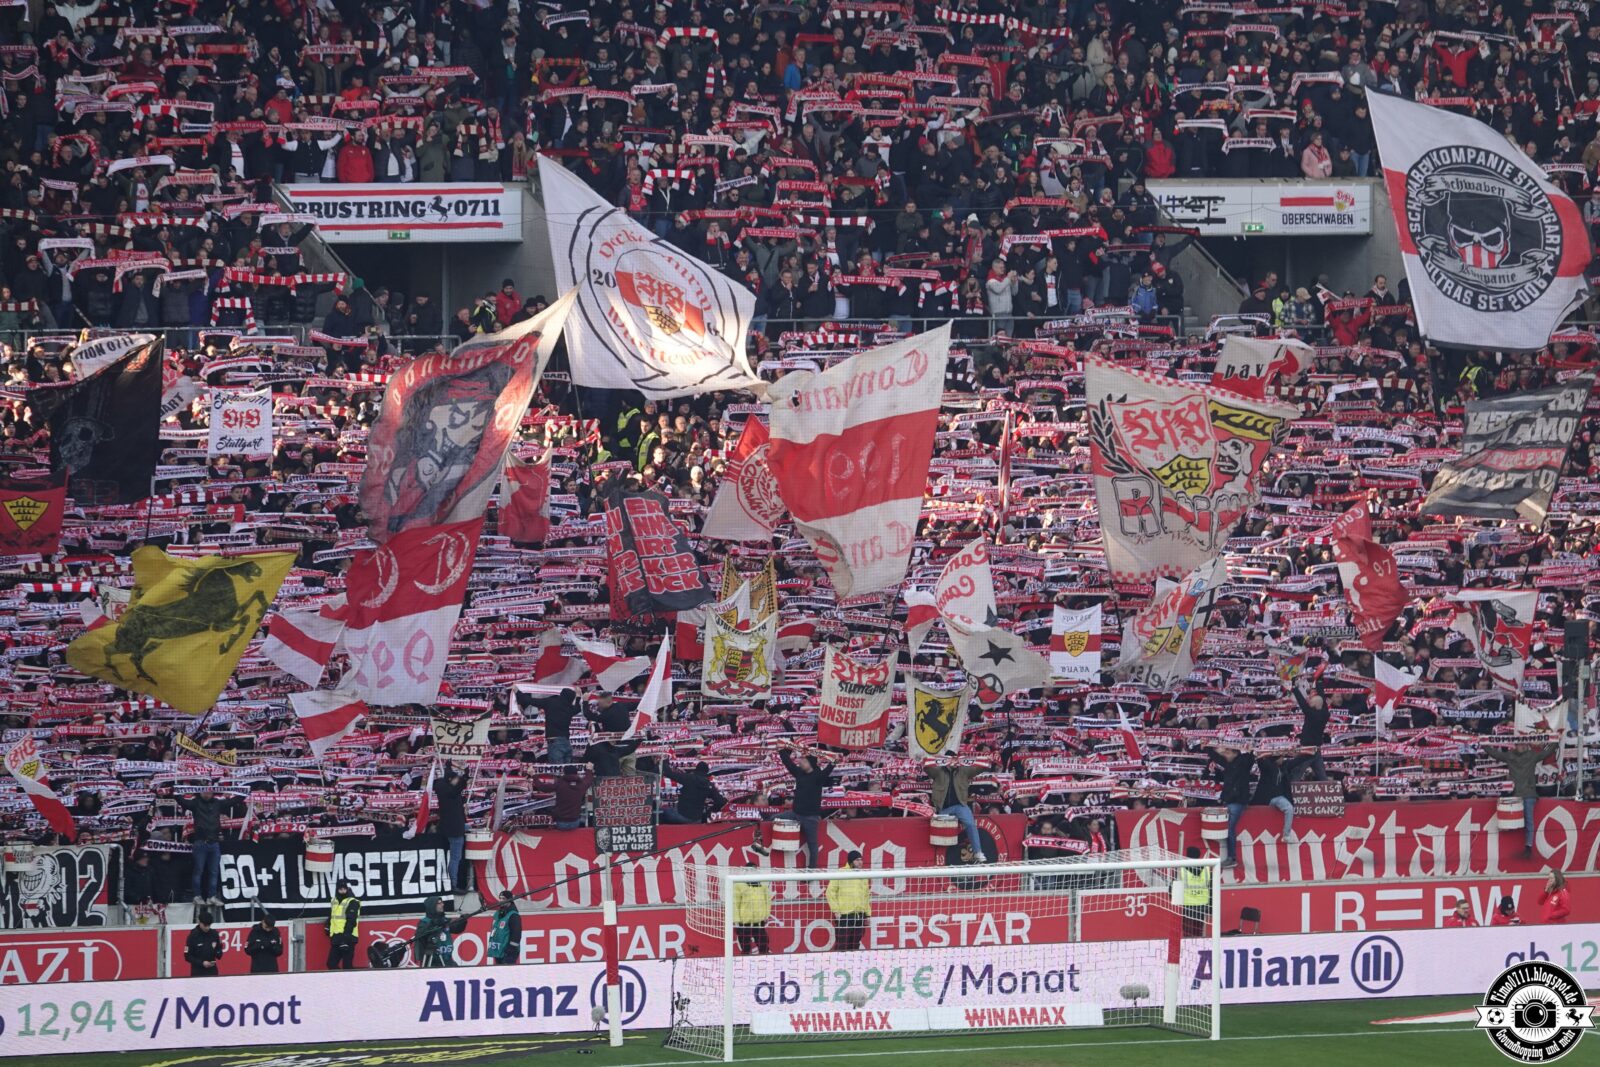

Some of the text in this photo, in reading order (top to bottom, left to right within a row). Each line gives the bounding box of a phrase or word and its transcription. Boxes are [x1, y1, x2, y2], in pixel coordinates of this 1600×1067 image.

[454, 199, 501, 217] 0711
[1281, 212, 1354, 226] OBERSCHWABEN
[592, 268, 616, 289] 20
[107, 334, 136, 357] 0711
[222, 408, 261, 430] VfB
[215, 436, 265, 453] Stuttgart
[203, 535, 251, 544] STUTTGART
[835, 695, 866, 709] HEISST
[820, 704, 857, 726] UNSER
[1441, 708, 1508, 719] KESSELSTADT
[839, 727, 880, 747] VEREIN
[1488, 735, 1550, 743] COMMANDO
[600, 776, 645, 786] JEDER
[1478, 783, 1503, 791] RAS
[593, 784, 652, 798] VERBANNTE
[1325, 784, 1342, 793] IST
[1417, 787, 1440, 795] RAS
[600, 796, 647, 807] KEHRT
[821, 799, 872, 808] Commando
[1314, 806, 1345, 817] GANZE
[612, 825, 653, 835] DU BIST
[612, 833, 654, 844] IMMER
[146, 840, 193, 852] COMMAN
[612, 842, 654, 851] BEI UNS!
[219, 848, 452, 900] 50+1 UMSETZEN
[1124, 894, 1148, 918] 35
[784, 911, 1032, 953] JOERSTAR
[219, 930, 243, 952] 34
[1191, 947, 1340, 991] Allianz
[754, 970, 801, 1006] ab
[418, 977, 578, 1023] Allianz
[789, 1005, 1068, 1033] WINAMAX WINAMAX
